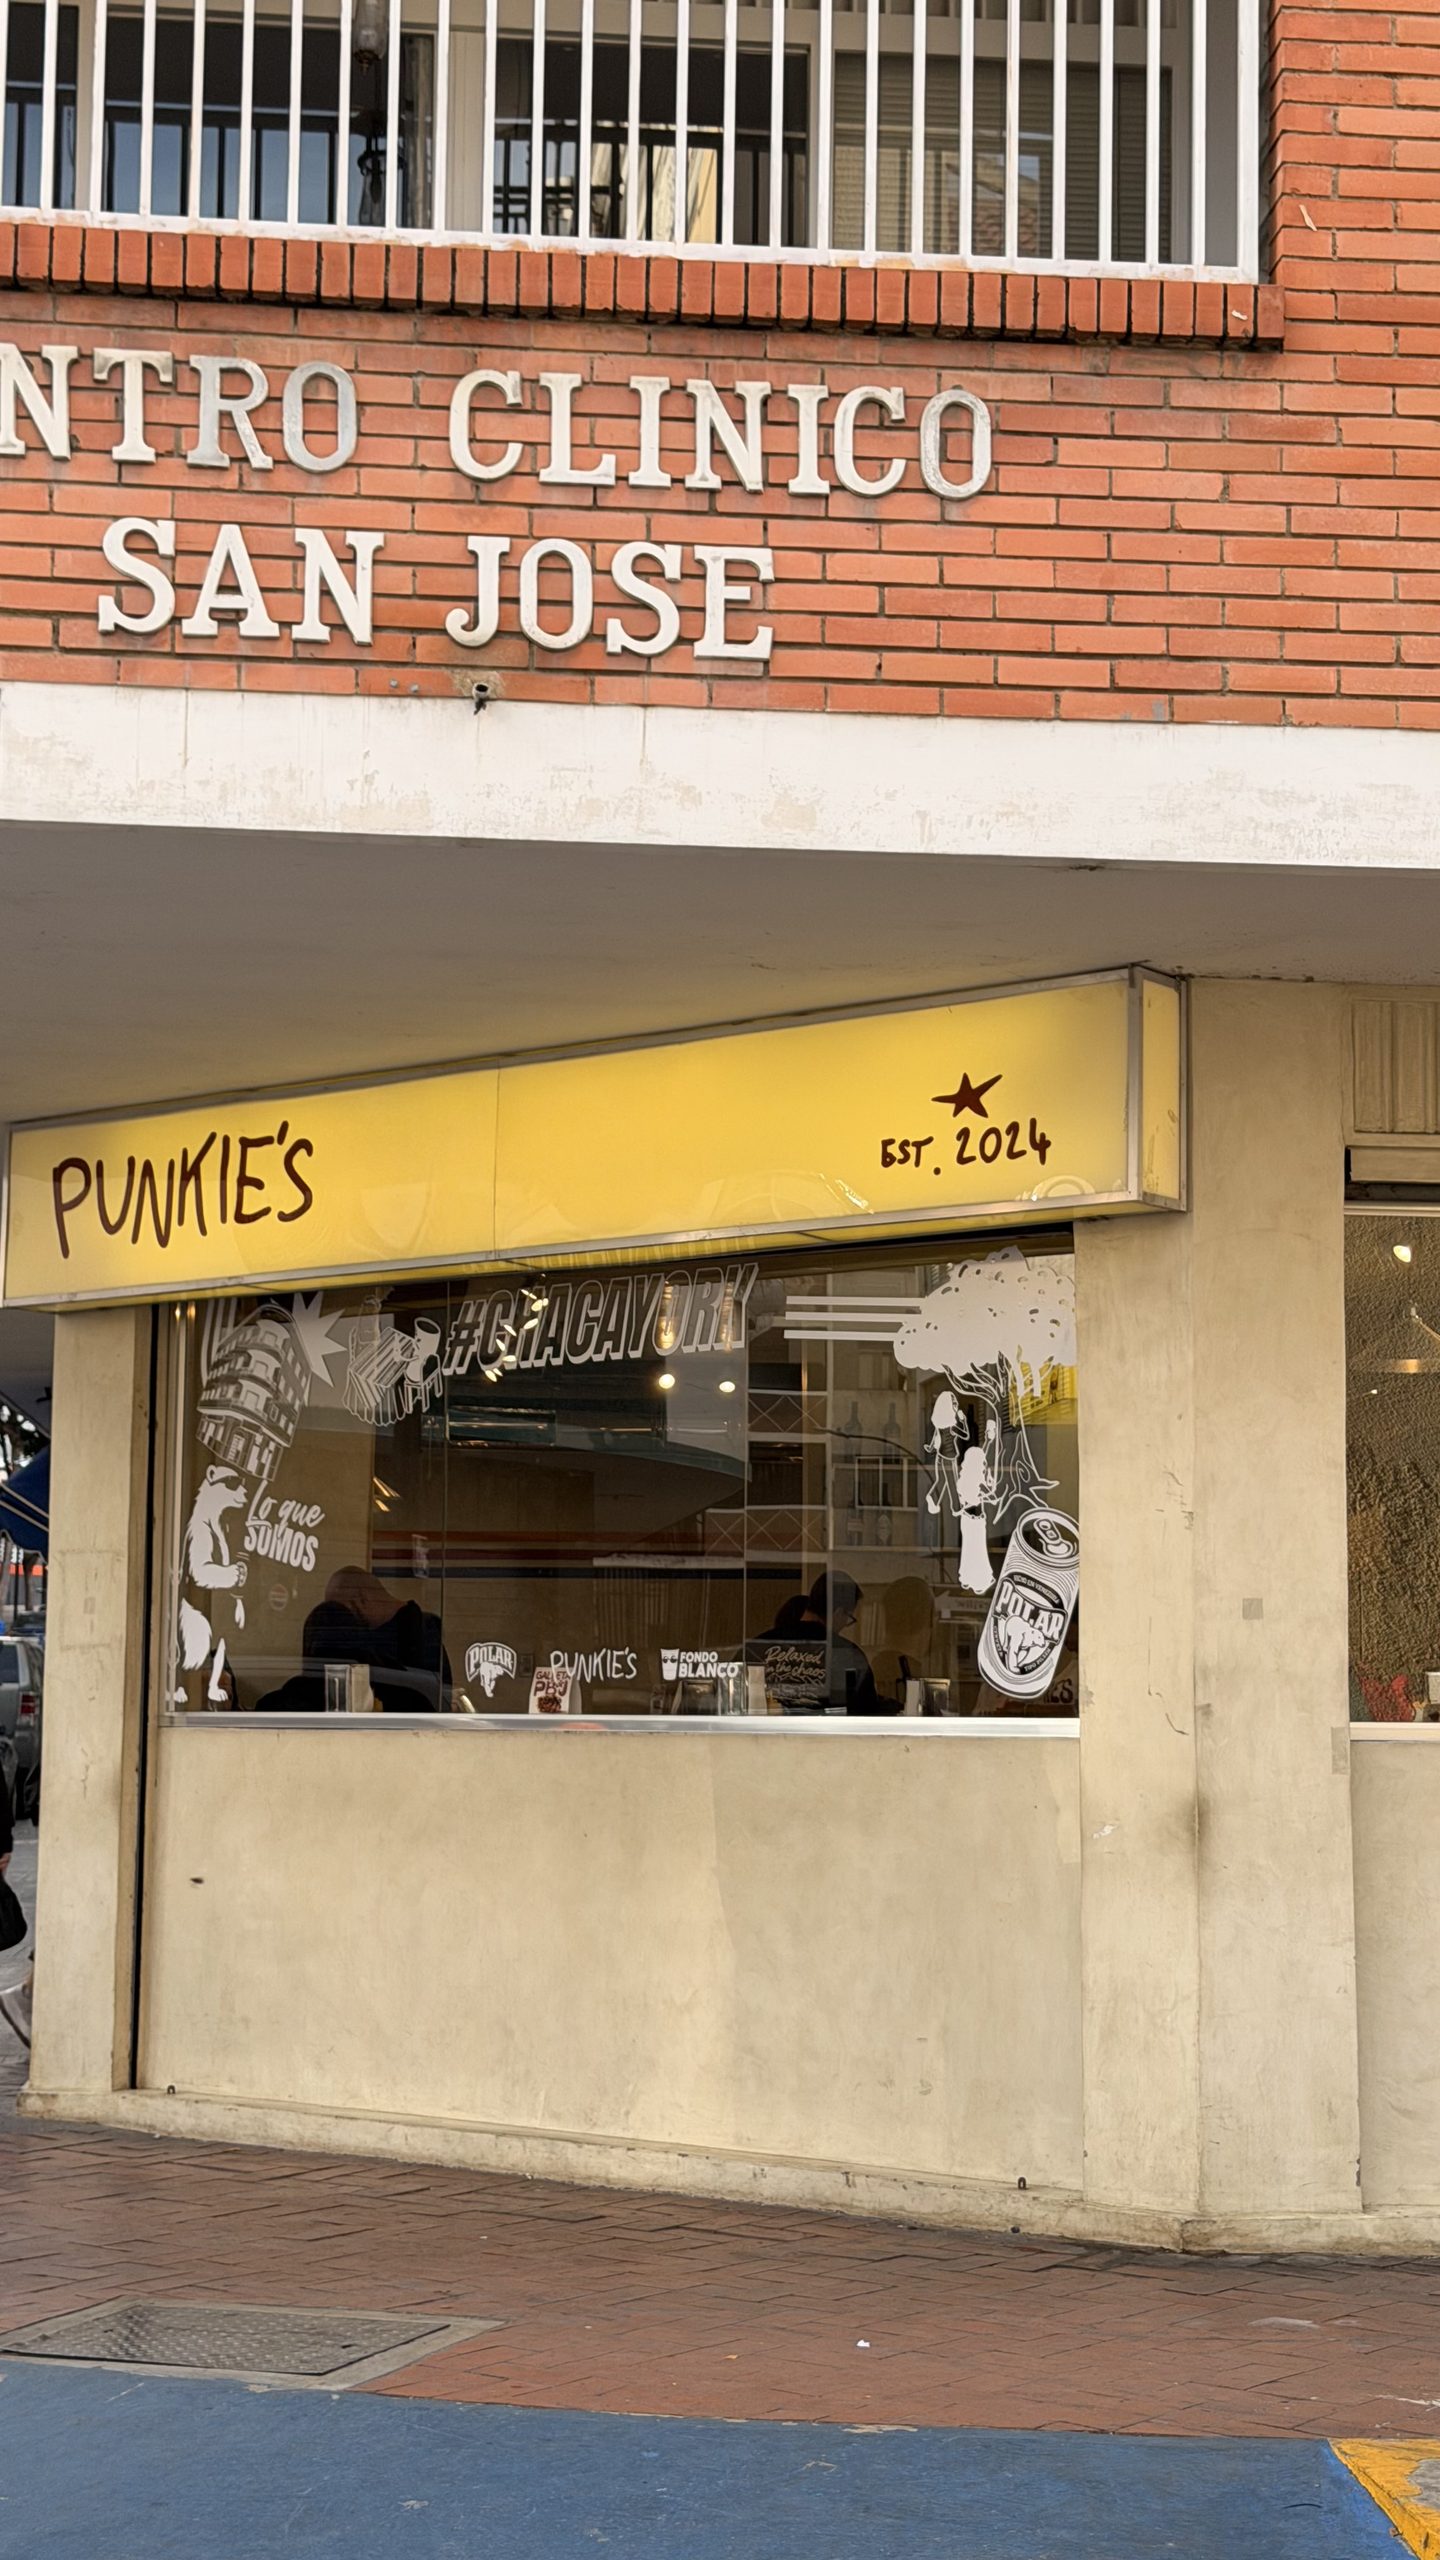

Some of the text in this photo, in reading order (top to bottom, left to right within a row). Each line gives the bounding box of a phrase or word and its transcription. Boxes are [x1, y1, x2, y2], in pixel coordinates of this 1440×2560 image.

[0, 343, 993, 500] NTRO CLINICO
[98, 516, 775, 661] SAN JOSE
[880, 1117, 1052, 1176] EST. 2024
[52, 1120, 314, 1260] PUNKIE'S
[245, 1479, 326, 1540] Lo que
[243, 1524, 319, 1573] SOMOS
[995, 1580, 1065, 1642] POLAR
[469, 1646, 514, 1675] POLAR
[550, 1646, 637, 1684] PUNKIE'S
[678, 1662, 739, 1678] BLANCO
[680, 1651, 718, 1663] FONDO
[765, 1645, 825, 1665] Relaxed
